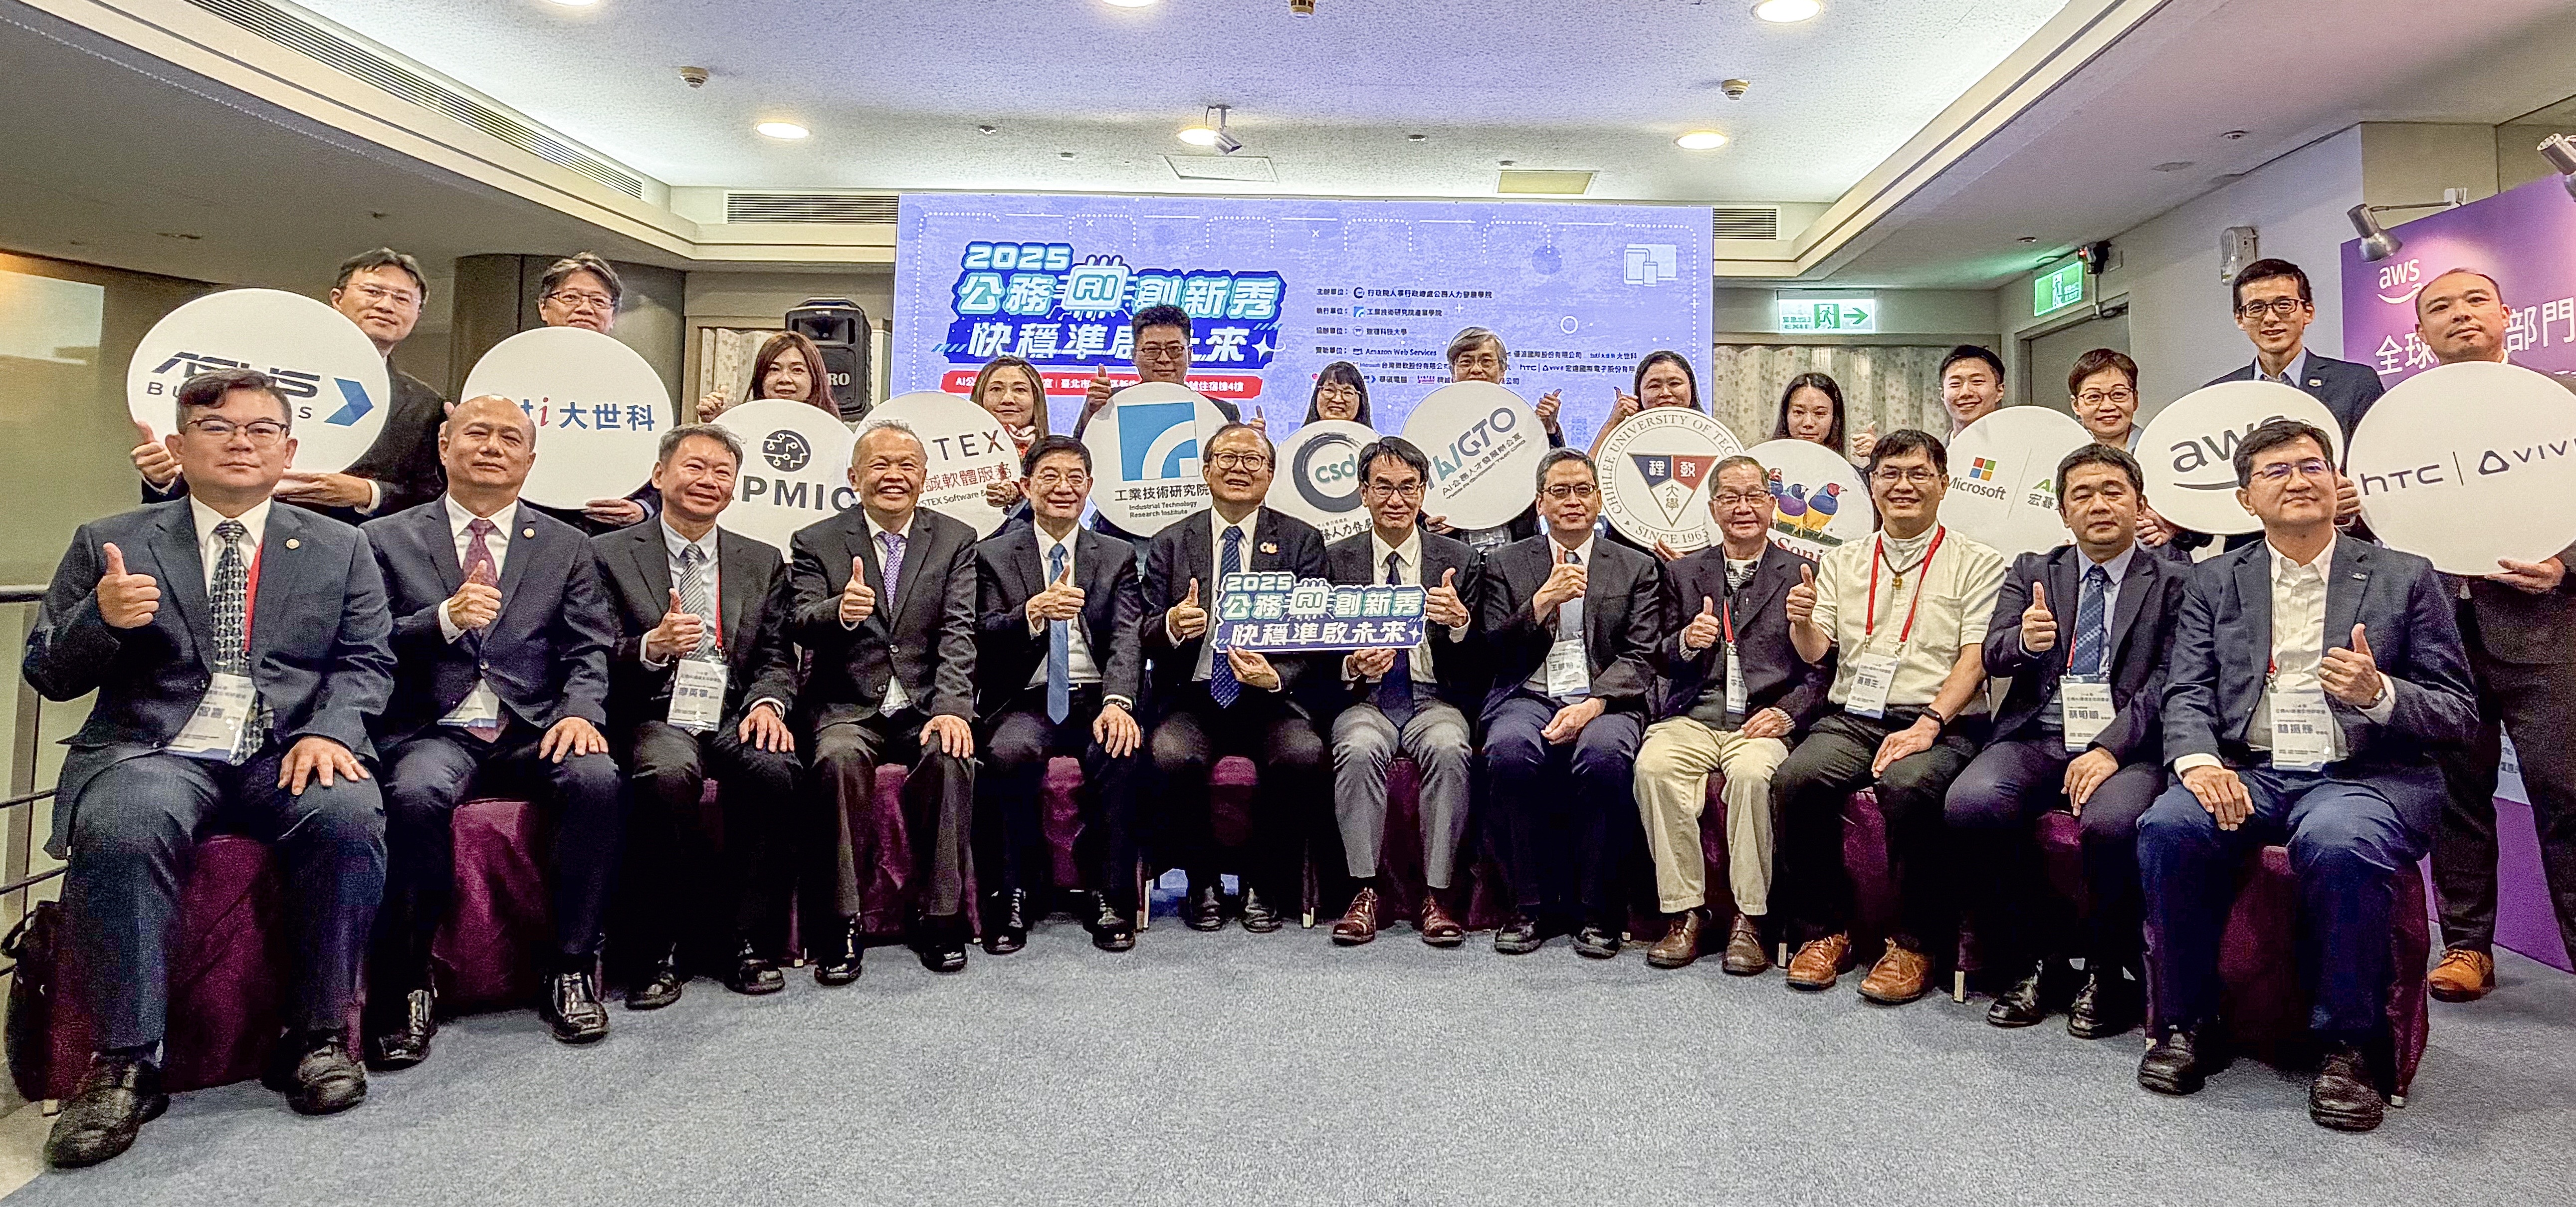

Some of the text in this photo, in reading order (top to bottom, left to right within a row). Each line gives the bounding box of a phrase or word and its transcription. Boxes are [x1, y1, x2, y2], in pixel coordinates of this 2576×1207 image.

[966, 245, 1072, 270] 2025
[2378, 258, 2420, 289] aws
[968, 322, 1250, 363] 快穩準來
[559, 402, 655, 431] 大世科
[1693, 420, 1712, 433] OF
[1609, 415, 1689, 452] UNIVERSITY
[2170, 415, 2287, 473] aw
[2513, 438, 2576, 463] VIV
[943, 491, 979, 503] Software
[1115, 484, 1210, 501] 工業技術研究院
[1602, 456, 1622, 514] CHIHLEE
[2027, 493, 2059, 510] 宏碁
[1635, 526, 1709, 544] SINCE 1965
[1226, 575, 1292, 591] 2025
[1223, 591, 1423, 620] 公務AI創新秀
[1232, 621, 1407, 647] 快穩準啟未來
